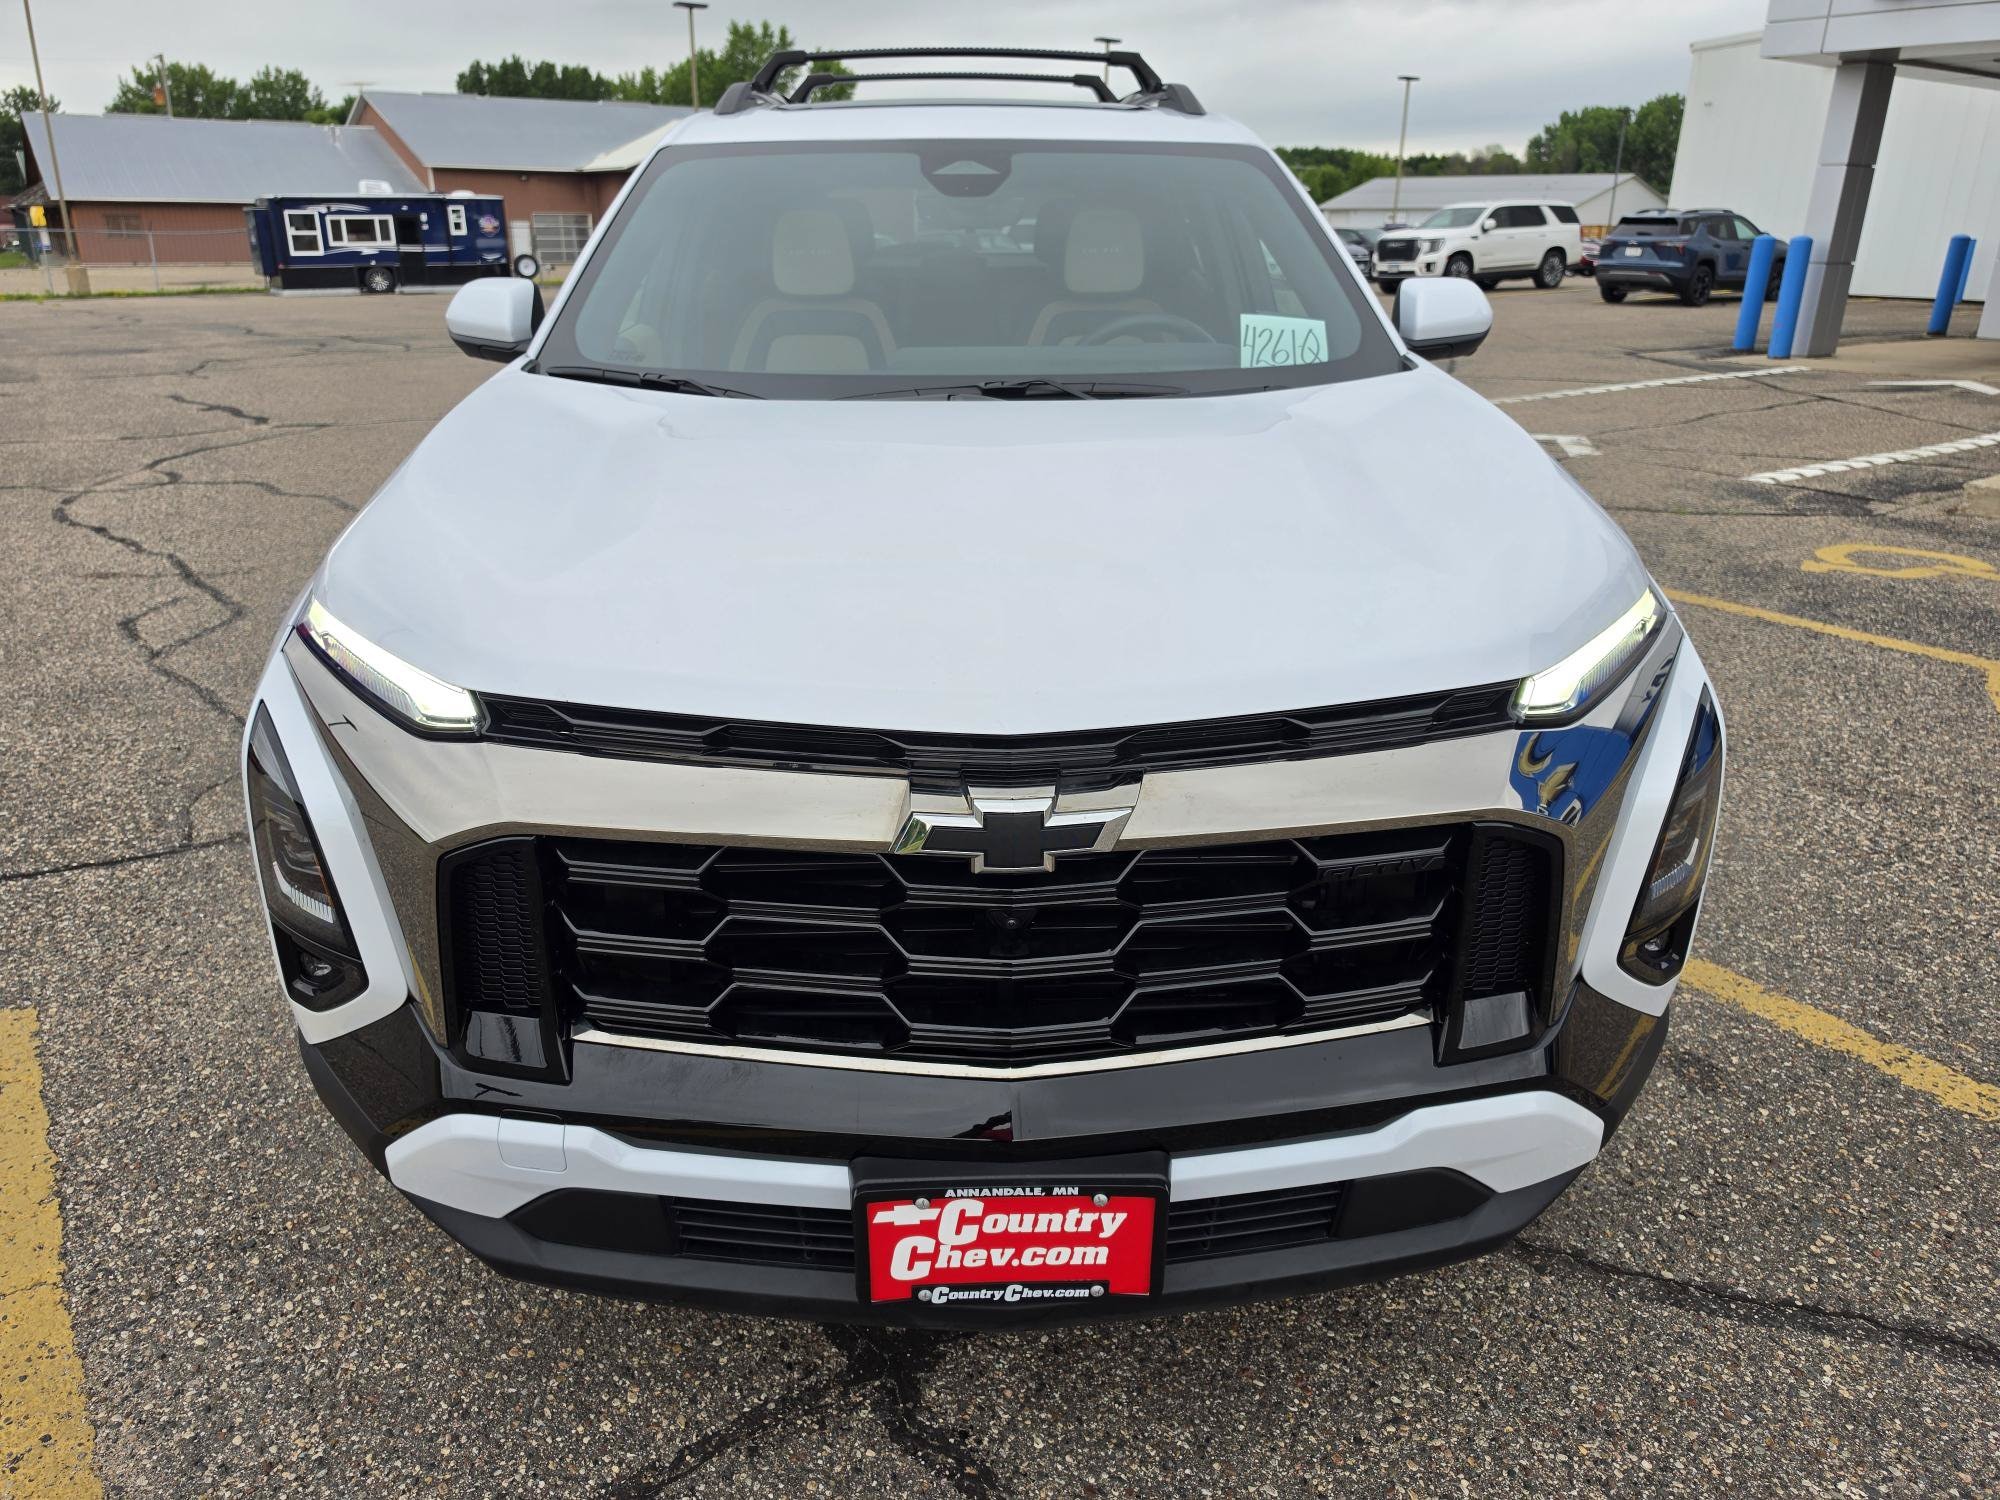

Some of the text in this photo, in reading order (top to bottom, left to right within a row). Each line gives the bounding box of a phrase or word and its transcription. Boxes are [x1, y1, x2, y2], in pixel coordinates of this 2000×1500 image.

[945, 1186, 1079, 1198] ANNANDALE, MN
[937, 1199, 1128, 1246] Country
[890, 1236, 1109, 1280] Chev.com
[931, 1284, 1090, 1304] CountryChev.com
